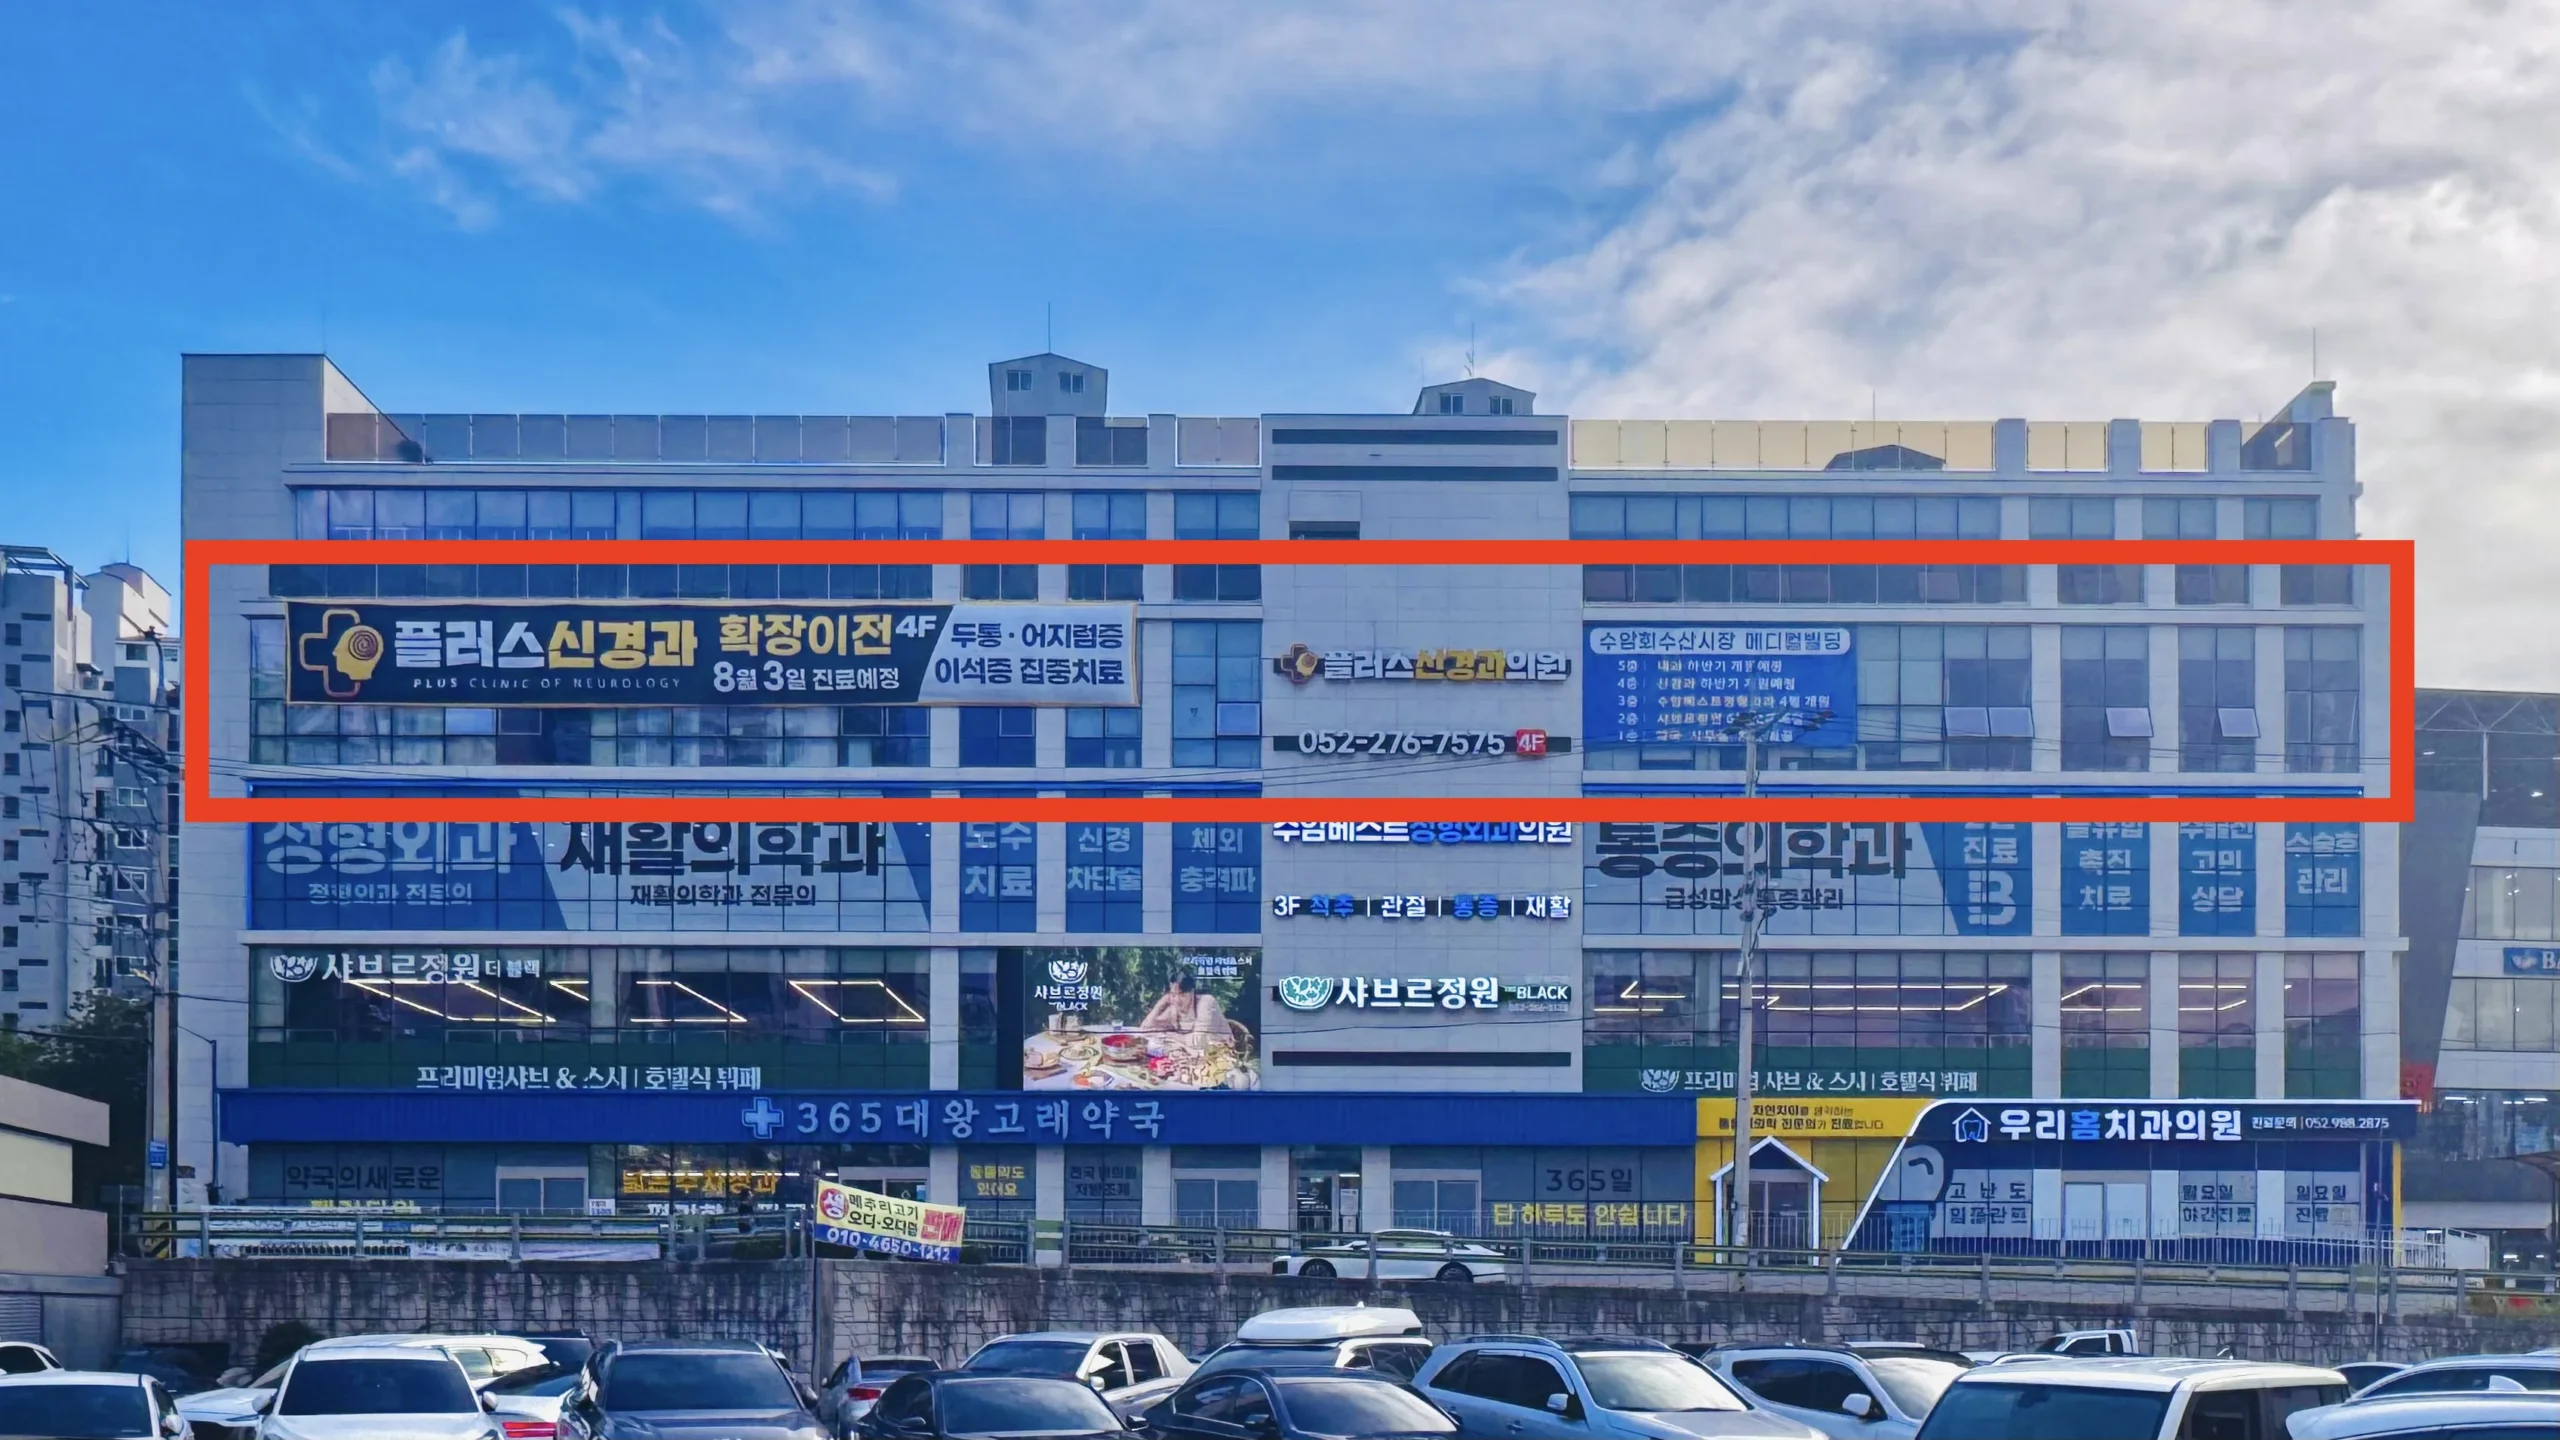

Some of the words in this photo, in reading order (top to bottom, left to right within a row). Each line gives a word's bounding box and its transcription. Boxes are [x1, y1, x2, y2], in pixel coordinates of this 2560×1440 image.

[395, 620, 697, 669] 플러스신경과
[719, 613, 893, 656] 확장이전
[895, 616, 936, 638] 4F
[951, 622, 1003, 649] 두통
[1021, 622, 1125, 650] 어지럼증
[1600, 631, 1735, 651] 수암회수산시장
[1745, 631, 1841, 651] 메디컬빌딩
[713, 661, 758, 693] 8월
[763, 660, 806, 692] 3일
[812, 667, 900, 692] 진료예정
[934, 657, 1013, 685] 이석증
[1020, 657, 1125, 686] 집중치료
[1324, 649, 1571, 681] 플러스신경과의원
[1688, 660, 1726, 672] 하반기
[413, 677, 459, 690] PLUS
[469, 677, 531, 690] CLINIC
[541, 677, 562, 690] OF
[573, 677, 682, 690] NEUROLOGY
[1700, 678, 1739, 690] 하반기
[1299, 729, 1506, 755] 052-276-7575
[1518, 732, 1545, 753] 4F
[560, 822, 886, 876] 재활의학과
[1079, 827, 1131, 853] 신경
[1191, 827, 1244, 854] 체외
[1964, 836, 2018, 864] 진료
[2079, 849, 2131, 875] 촉진
[2192, 850, 2243, 876] 고민
[965, 865, 1033, 897] 치료
[1067, 865, 1142, 892] 차단술
[1180, 866, 1256, 893] 충격파
[2297, 868, 2348, 894] 관리
[406, 883, 473, 905] 전문의
[630, 884, 743, 907] 재활의학과
[750, 884, 817, 907] 전문의
[1274, 895, 1301, 916] 3F
[1381, 895, 1426, 918] 관절
[1453, 894, 1500, 918] 통증
[1525, 895, 1571, 918] 재활
[2079, 885, 2132, 911] 치료
[2192, 886, 2243, 912] 상담
[322, 953, 480, 984] 샤브르정원
[1336, 977, 1499, 1009] 샤브르정원
[1517, 986, 1568, 999] BLACK
[556, 1067, 577, 1089] &
[583, 1066, 627, 1090] 스시
[717, 1066, 762, 1090] 뷔페
[1829, 1071, 1865, 1092] 스시
[1880, 1071, 1936, 1092] 호텔식
[1941, 1072, 1977, 1092] 뷔페
[2000, 1108, 2242, 1141] 우리홈치과의원
[1546, 1168, 1633, 1193] 365일
[848, 1194, 918, 1220] 메추리고기
[1493, 1204, 1513, 1225] 단
[1522, 1203, 1587, 1225] 하루도
[2183, 1207, 2251, 1223] 야간진료
[827, 1228, 950, 1260] 010-4650-1212
